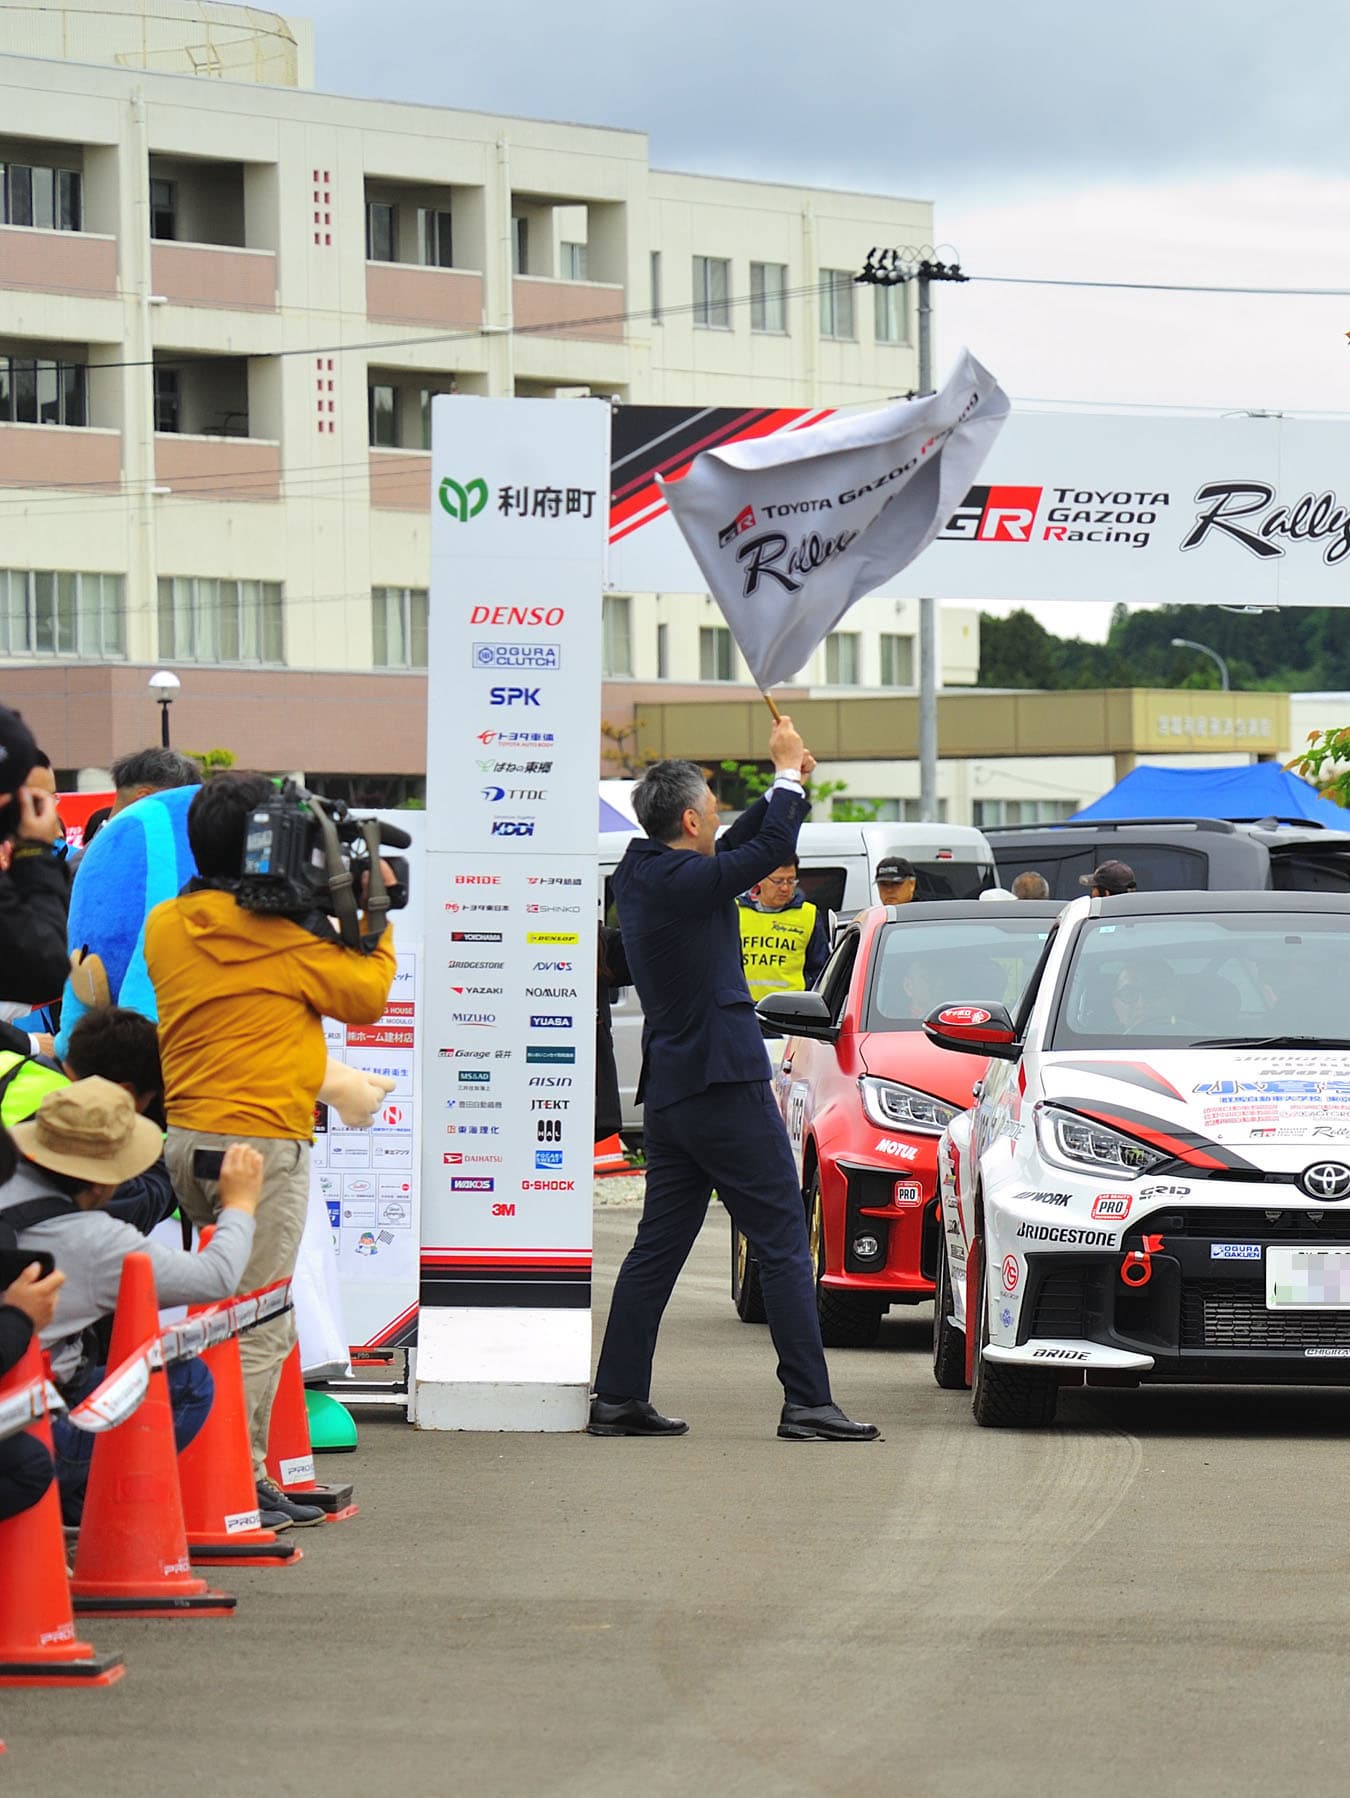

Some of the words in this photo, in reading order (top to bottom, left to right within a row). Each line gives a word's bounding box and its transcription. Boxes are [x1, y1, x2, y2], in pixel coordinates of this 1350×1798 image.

[498, 486, 596, 518] 利府町
[1053, 488, 1169, 505] TOYOTA
[718, 505, 756, 548] GR
[762, 498, 832, 519] TOYOTA
[838, 458, 917, 505] GAZOO
[939, 500, 1036, 540] GR
[1047, 507, 1156, 524] GAZOO
[1043, 526, 1150, 549] Racing
[470, 606, 564, 626] DENSO
[497, 647, 555, 656] OGURA
[496, 657, 555, 666] CLUTCH
[490, 687, 541, 706] SPK
[492, 822, 535, 836] KDDI
[455, 875, 502, 885] BRIDE
[465, 933, 500, 941] YOKOHAMA
[743, 936, 796, 951] FFICIAL
[449, 960, 504, 969] BRIDGESTONE
[743, 954, 786, 966] STAFF
[526, 988, 577, 998] NOMURA
[390, 1007, 413, 1015] HOUSE
[452, 1013, 495, 1022] MIZUHO
[533, 1018, 569, 1026] YUASA
[455, 1050, 490, 1058] Garage
[529, 1078, 572, 1086] AISIN
[530, 1100, 569, 1111] JTEKT
[875, 1139, 918, 1160] MOTUL
[522, 1181, 575, 1190] G-SHOCK
[899, 1189, 915, 1200] PRO
[1032, 1192, 1072, 1207] WORK
[492, 1204, 515, 1216] 3M
[1099, 1200, 1124, 1213] PRO
[1017, 1222, 1117, 1247] BRIDGESTONE
[1033, 1349, 1091, 1361] BRIDE
